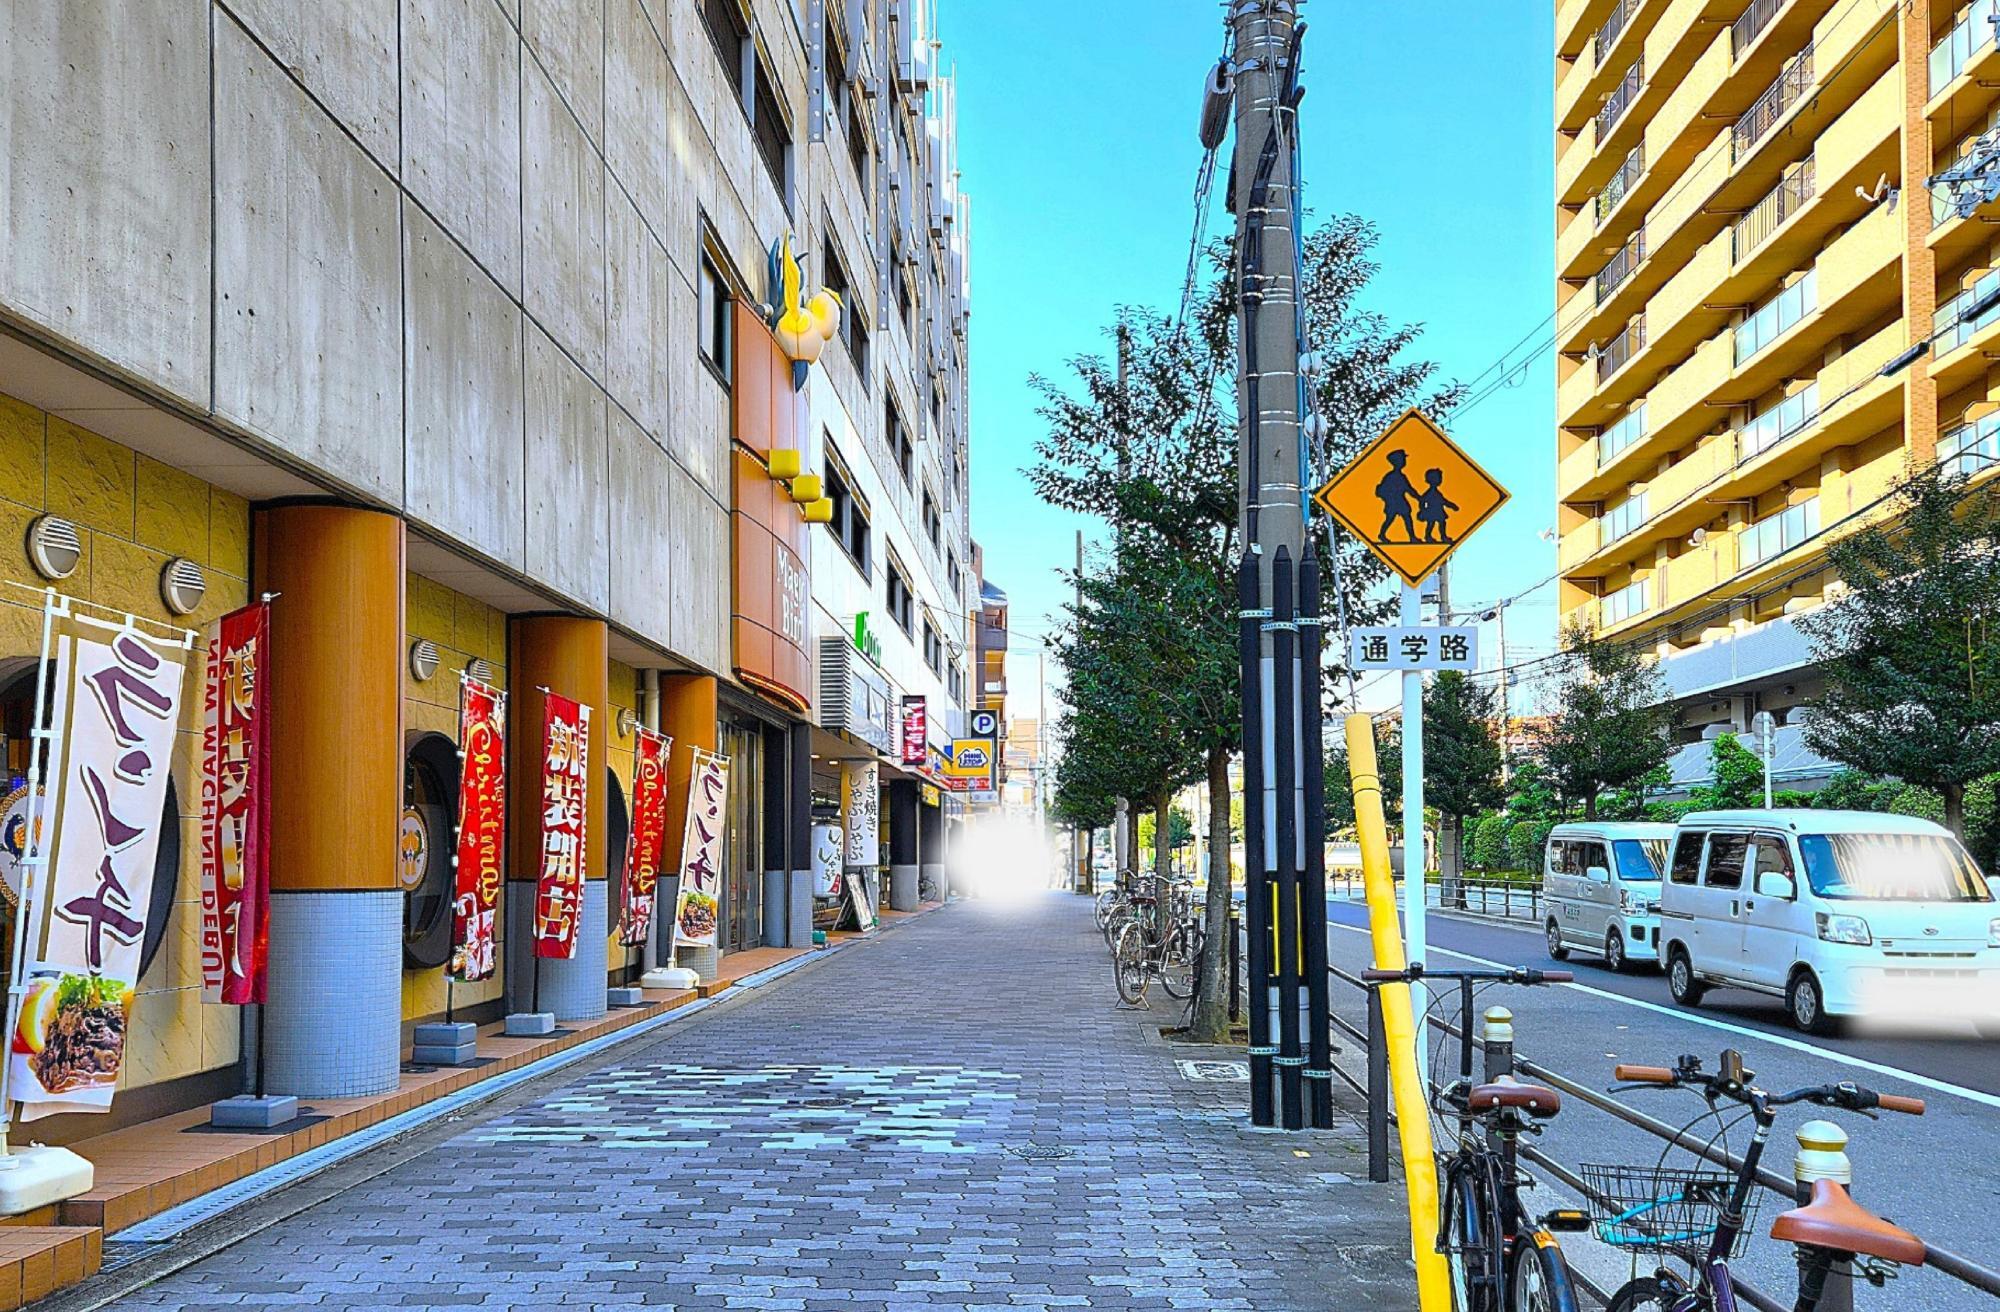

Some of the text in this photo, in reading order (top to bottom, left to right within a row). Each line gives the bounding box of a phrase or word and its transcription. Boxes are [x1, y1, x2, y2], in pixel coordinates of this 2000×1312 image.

[1360, 633, 1470, 663] 通学路
[978, 715, 992, 731] P
[469, 720, 499, 907] Christmas
[532, 715, 581, 943] 新装開店
[640, 758, 659, 894] Christmas
